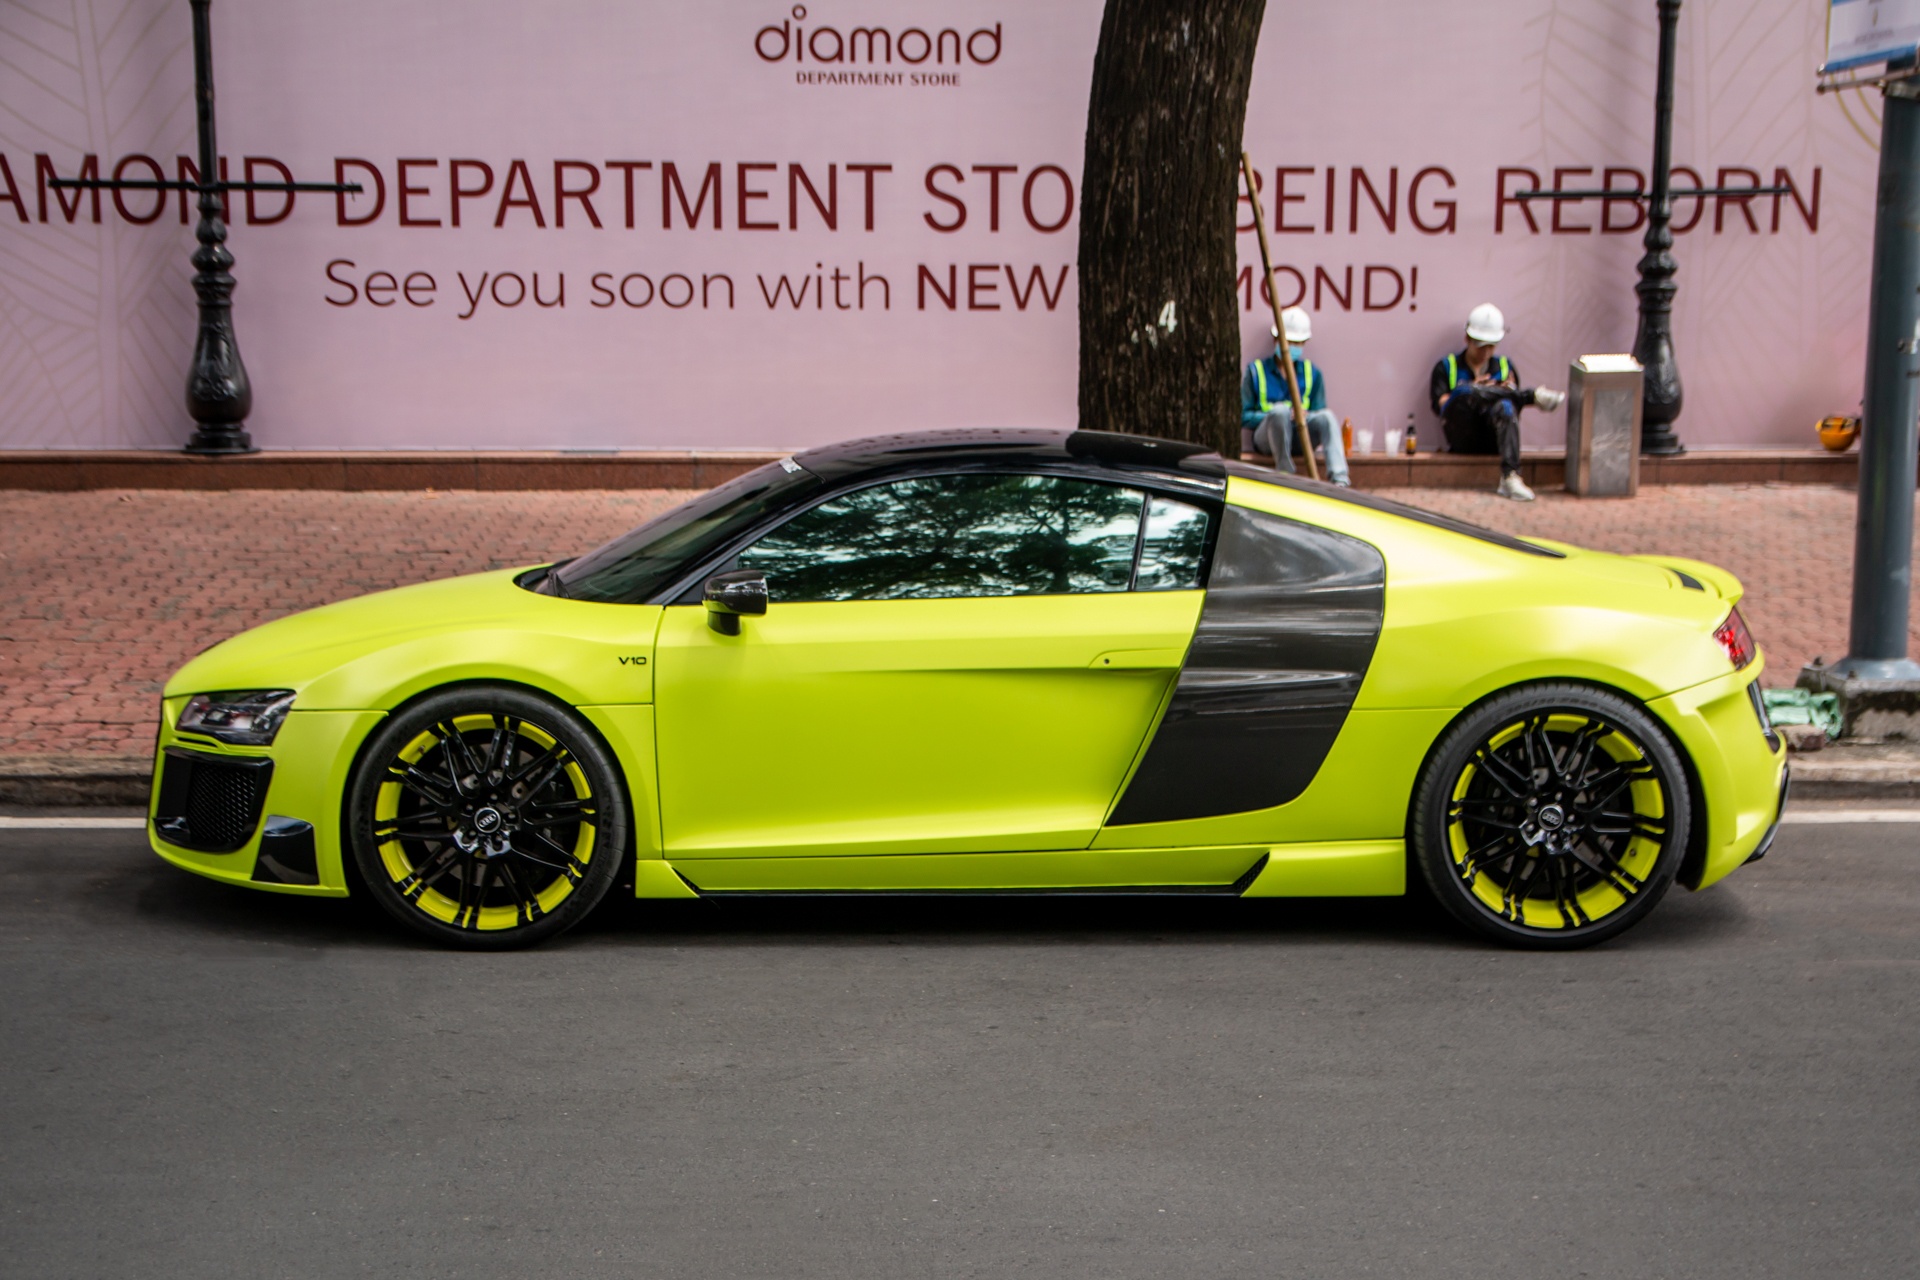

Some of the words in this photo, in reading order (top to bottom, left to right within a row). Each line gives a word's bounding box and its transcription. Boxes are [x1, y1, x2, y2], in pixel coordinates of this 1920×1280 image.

[754, 4, 1002, 65] diamond
[796, 72, 904, 86] DEPARTMENT
[910, 73, 961, 87] STORE
[334, 158, 892, 232] DEPARTMENT
[1494, 165, 1822, 235] REBORN
[324, 259, 437, 308] See
[457, 271, 565, 320] you
[590, 272, 735, 310] soon
[756, 260, 891, 311] with
[917, 264, 1070, 312] NEW
[618, 656, 647, 666] V10
